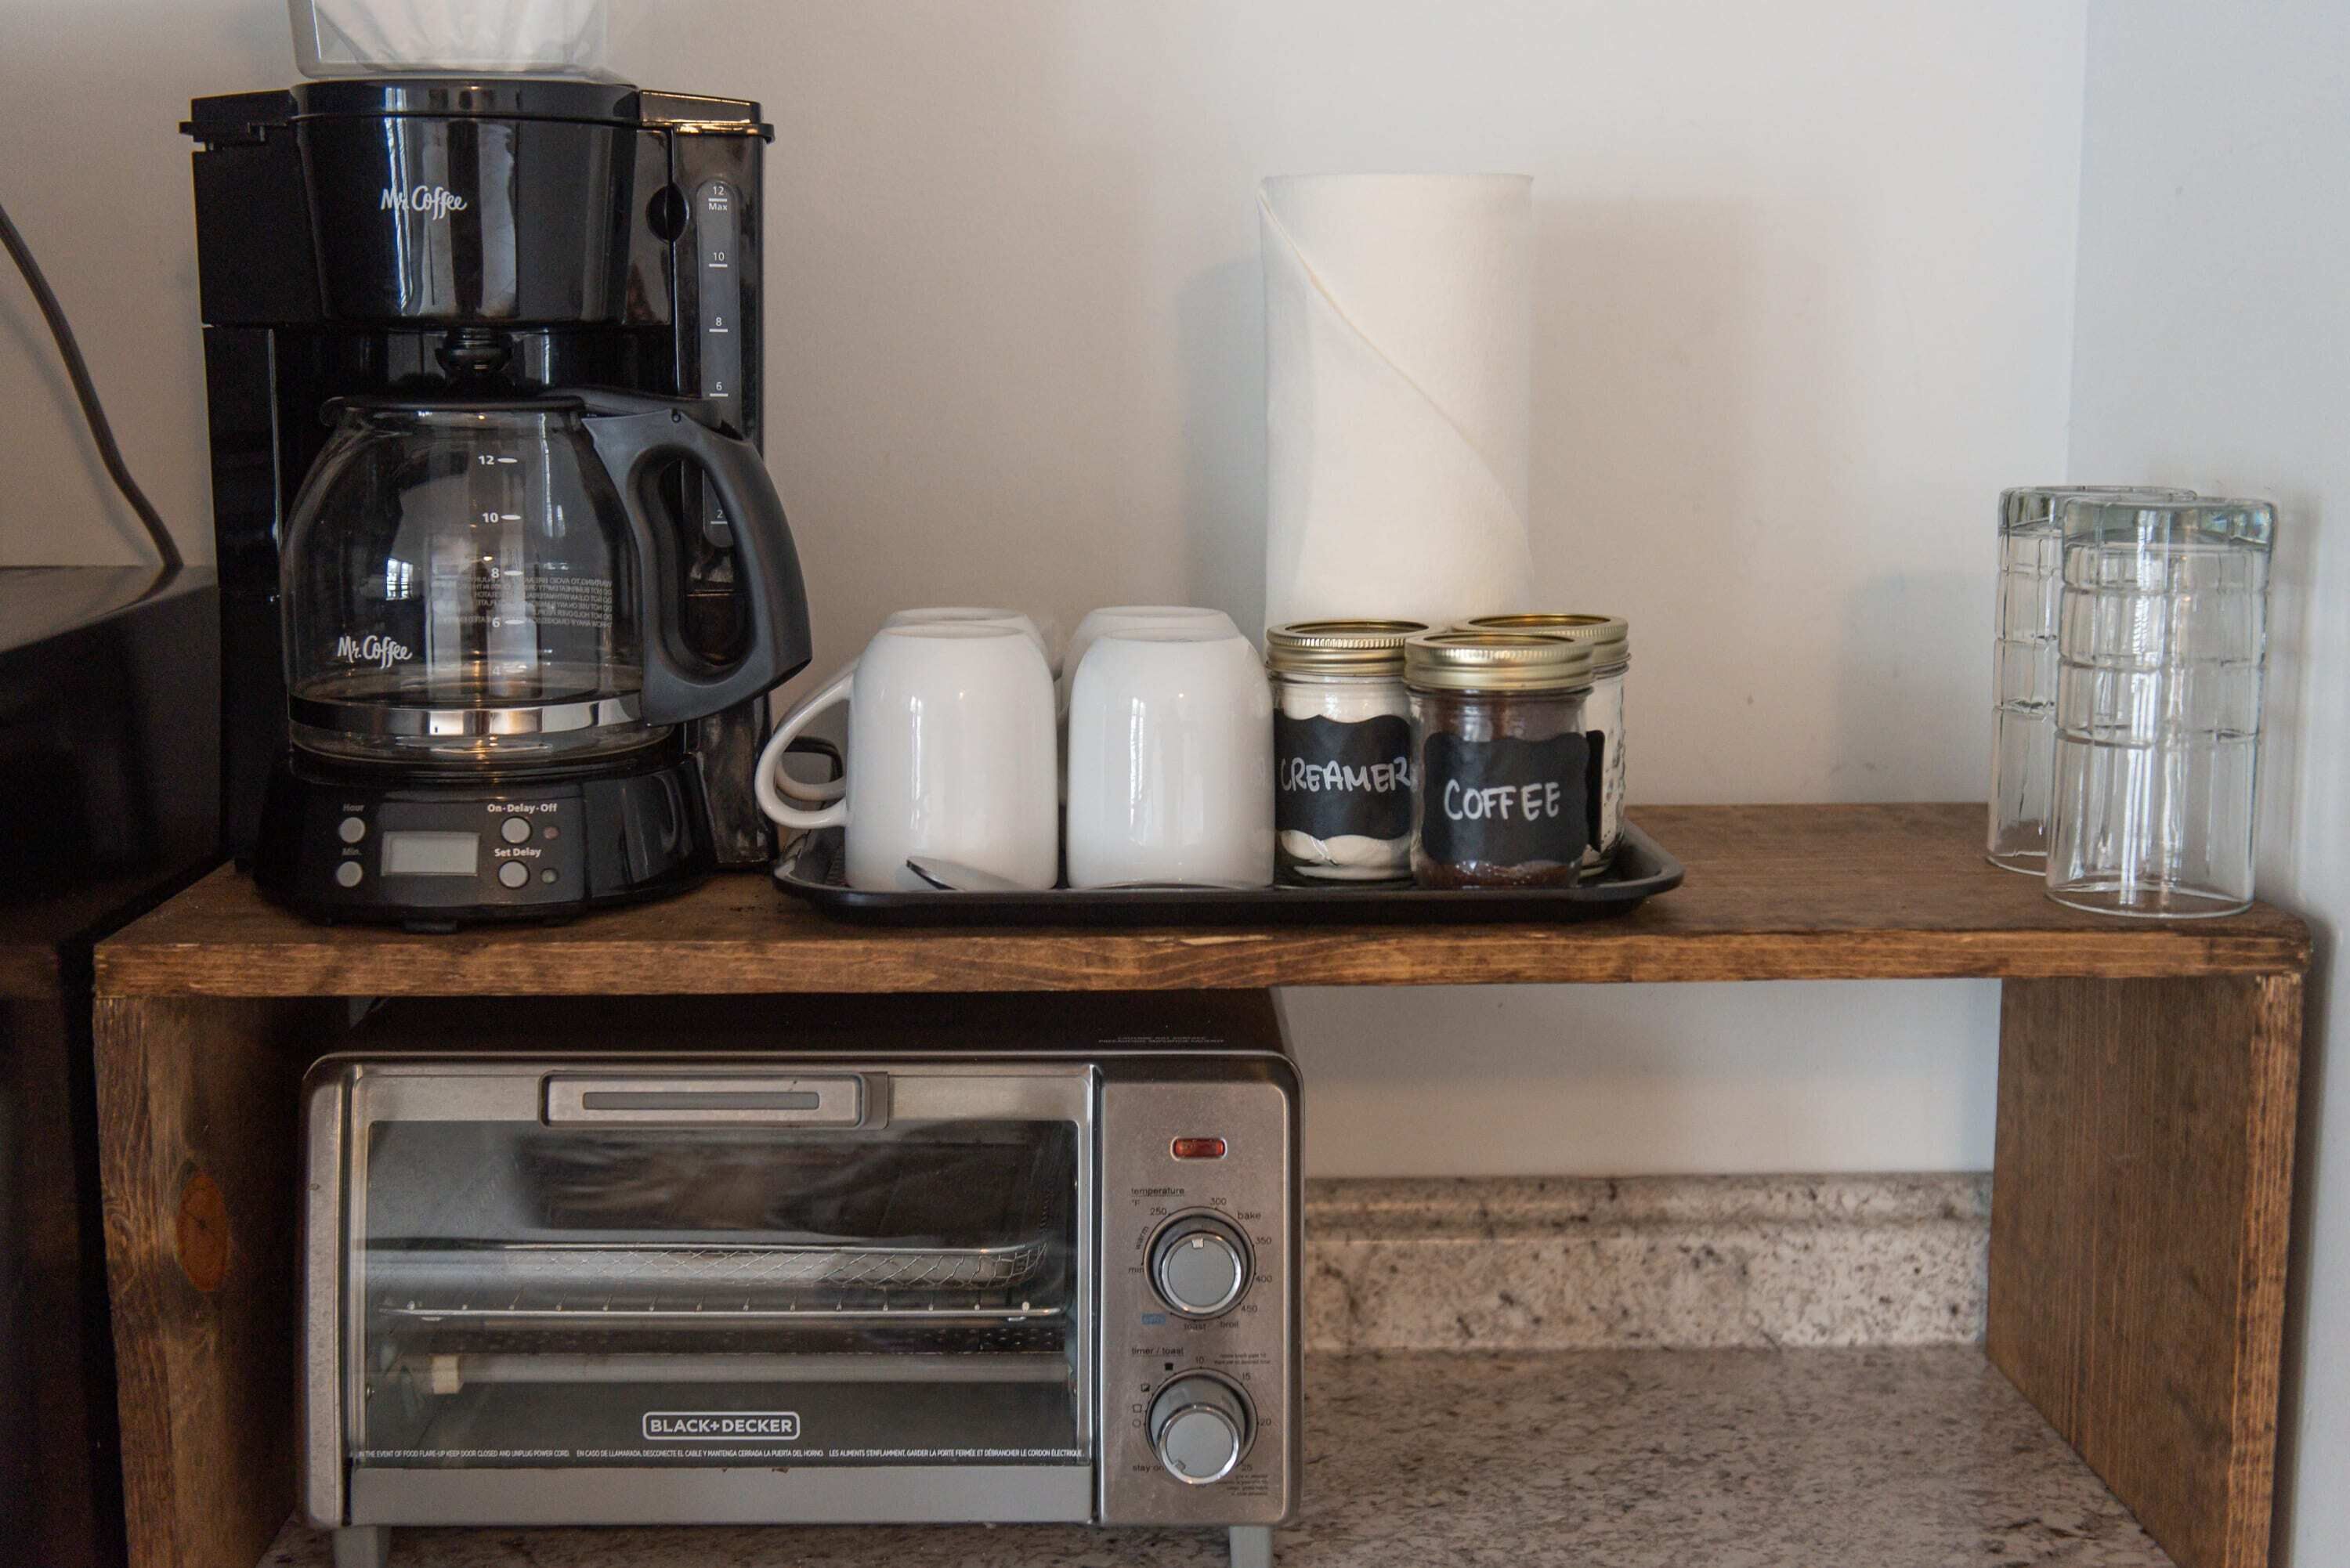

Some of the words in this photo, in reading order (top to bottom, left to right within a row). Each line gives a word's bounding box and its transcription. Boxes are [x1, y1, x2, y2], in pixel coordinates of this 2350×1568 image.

[713, 186, 725, 195] 12
[411, 186, 468, 220] Coffee
[708, 202, 728, 211] Max
[714, 251, 725, 261] 10
[715, 316, 722, 327] 8
[716, 381, 722, 391] 6
[478, 455, 495, 465] 12
[482, 512, 499, 523] 10
[717, 508, 723, 518] 2
[491, 567, 500, 579] 8
[492, 616, 501, 627] 6
[338, 636, 362, 663] Mr.
[363, 635, 413, 669] Coffee
[1281, 757, 1411, 793] CREAMER
[1444, 779, 1561, 821] COFFEE
[343, 803, 365, 812] Hour
[494, 848, 512, 857] Set
[512, 847, 542, 858] Delay
[1131, 1187, 1185, 1197] temperature
[1149, 1207, 1167, 1216] 250
[1184, 1322, 1207, 1331] toast
[1162, 1346, 1184, 1355] toast
[650, 1418, 792, 1433] BLACK+DECKER
[1260, 1418, 1272, 1426] 20
